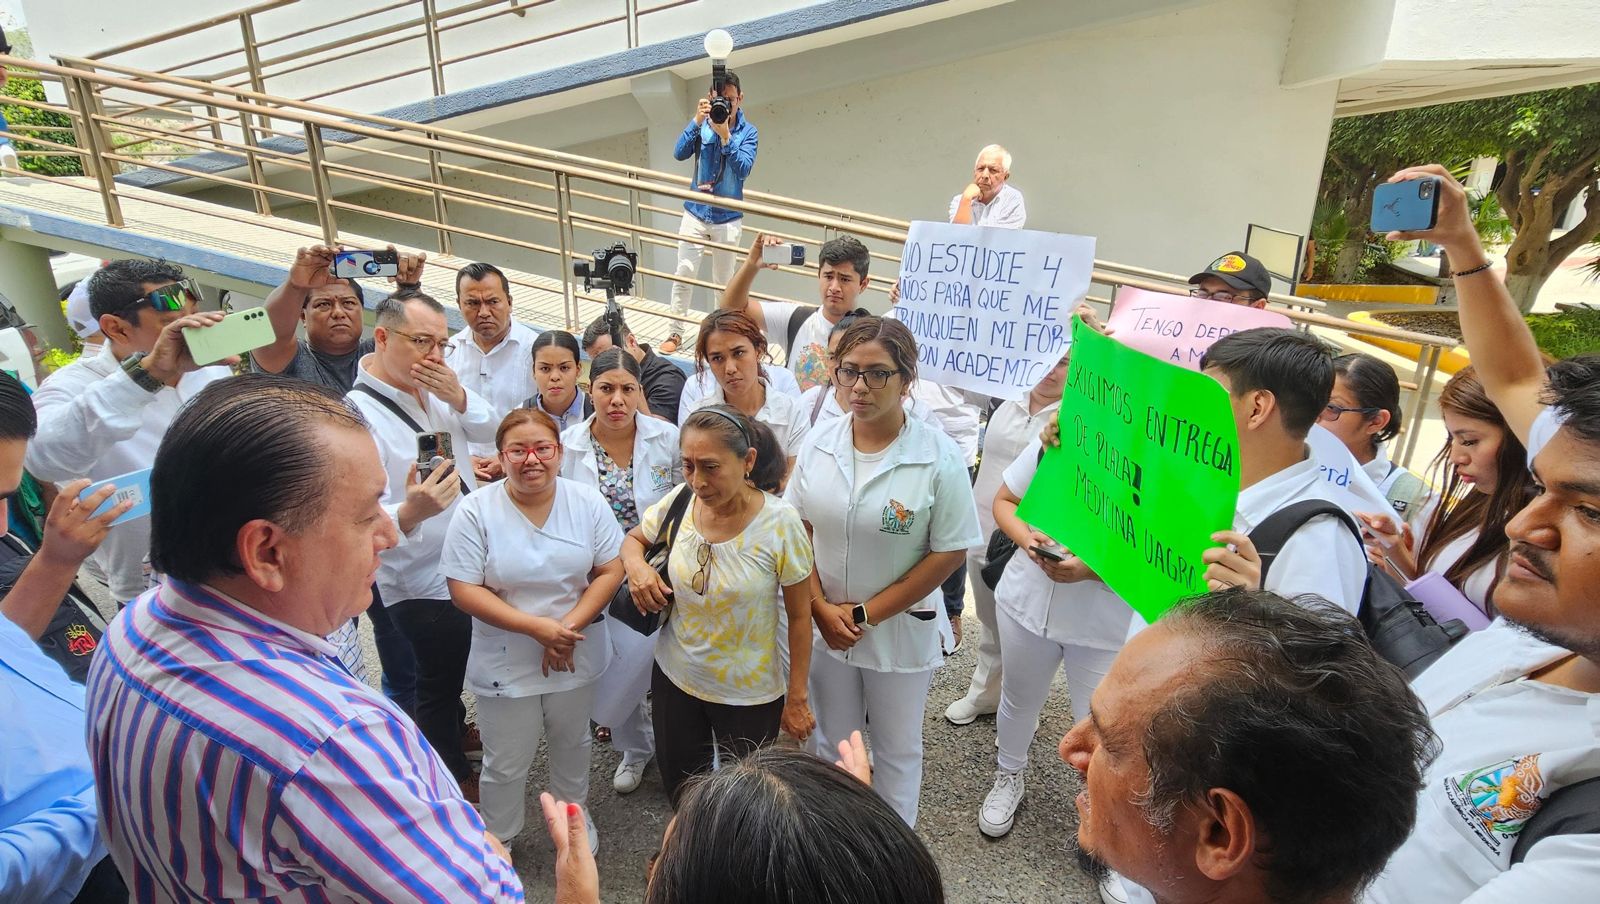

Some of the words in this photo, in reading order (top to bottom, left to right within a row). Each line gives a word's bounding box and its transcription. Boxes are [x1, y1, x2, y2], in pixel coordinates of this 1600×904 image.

[928, 243, 1026, 285] ESTUDIE
[1043, 255, 1063, 289] 4
[900, 275, 928, 301] ÑOS
[934, 281, 971, 309] PARA
[978, 287, 1013, 312] QUE
[1023, 295, 1060, 321] ME
[990, 320, 1018, 349] MI
[1024, 322, 1073, 355] FOR-
[1132, 307, 1184, 337] TENGO
[917, 342, 939, 368] ON
[1170, 347, 1181, 361] A
[1073, 414, 1090, 457] DE
[1145, 405, 1233, 477] ENTREGA
[1075, 463, 1137, 550] MEDICINA
[1144, 527, 1197, 593] UAGRO
